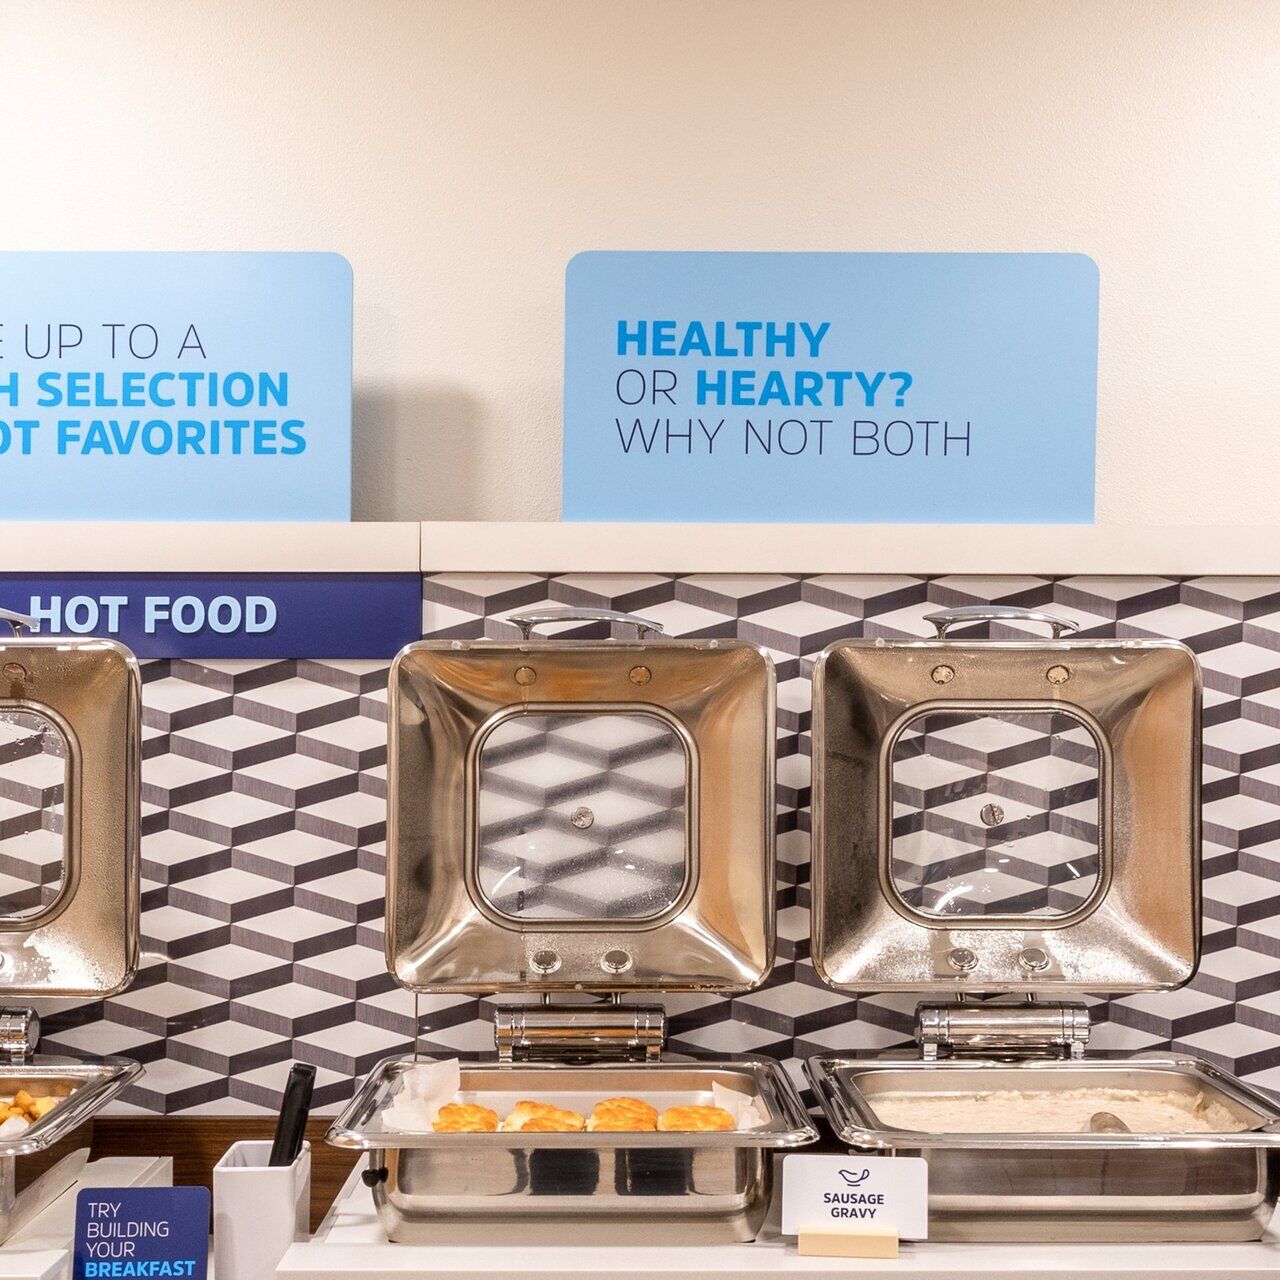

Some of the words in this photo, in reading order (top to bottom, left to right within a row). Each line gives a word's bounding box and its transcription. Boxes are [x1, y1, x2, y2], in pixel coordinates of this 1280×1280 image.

[24, 323, 84, 360] UP
[102, 323, 158, 360] TO
[177, 323, 206, 359] A
[617, 320, 831, 358] HEALTHY
[37, 371, 288, 408] SELECTION
[616, 369, 678, 406] OR
[696, 369, 913, 408] HEARTY?
[57, 419, 307, 456] FAVORITES
[615, 417, 725, 455] WHY
[745, 418, 833, 456] NOT
[852, 420, 972, 457] BOTH
[30, 595, 129, 634] HOT
[144, 595, 278, 635] FOOD
[88, 1202, 121, 1218] TRY
[824, 1193, 884, 1205] SAUSAGE
[831, 1207, 877, 1219] GRAVY
[87, 1221, 169, 1238] BUILDING
[86, 1241, 135, 1258] YOUR
[84, 1260, 196, 1278] BREAKFAST
